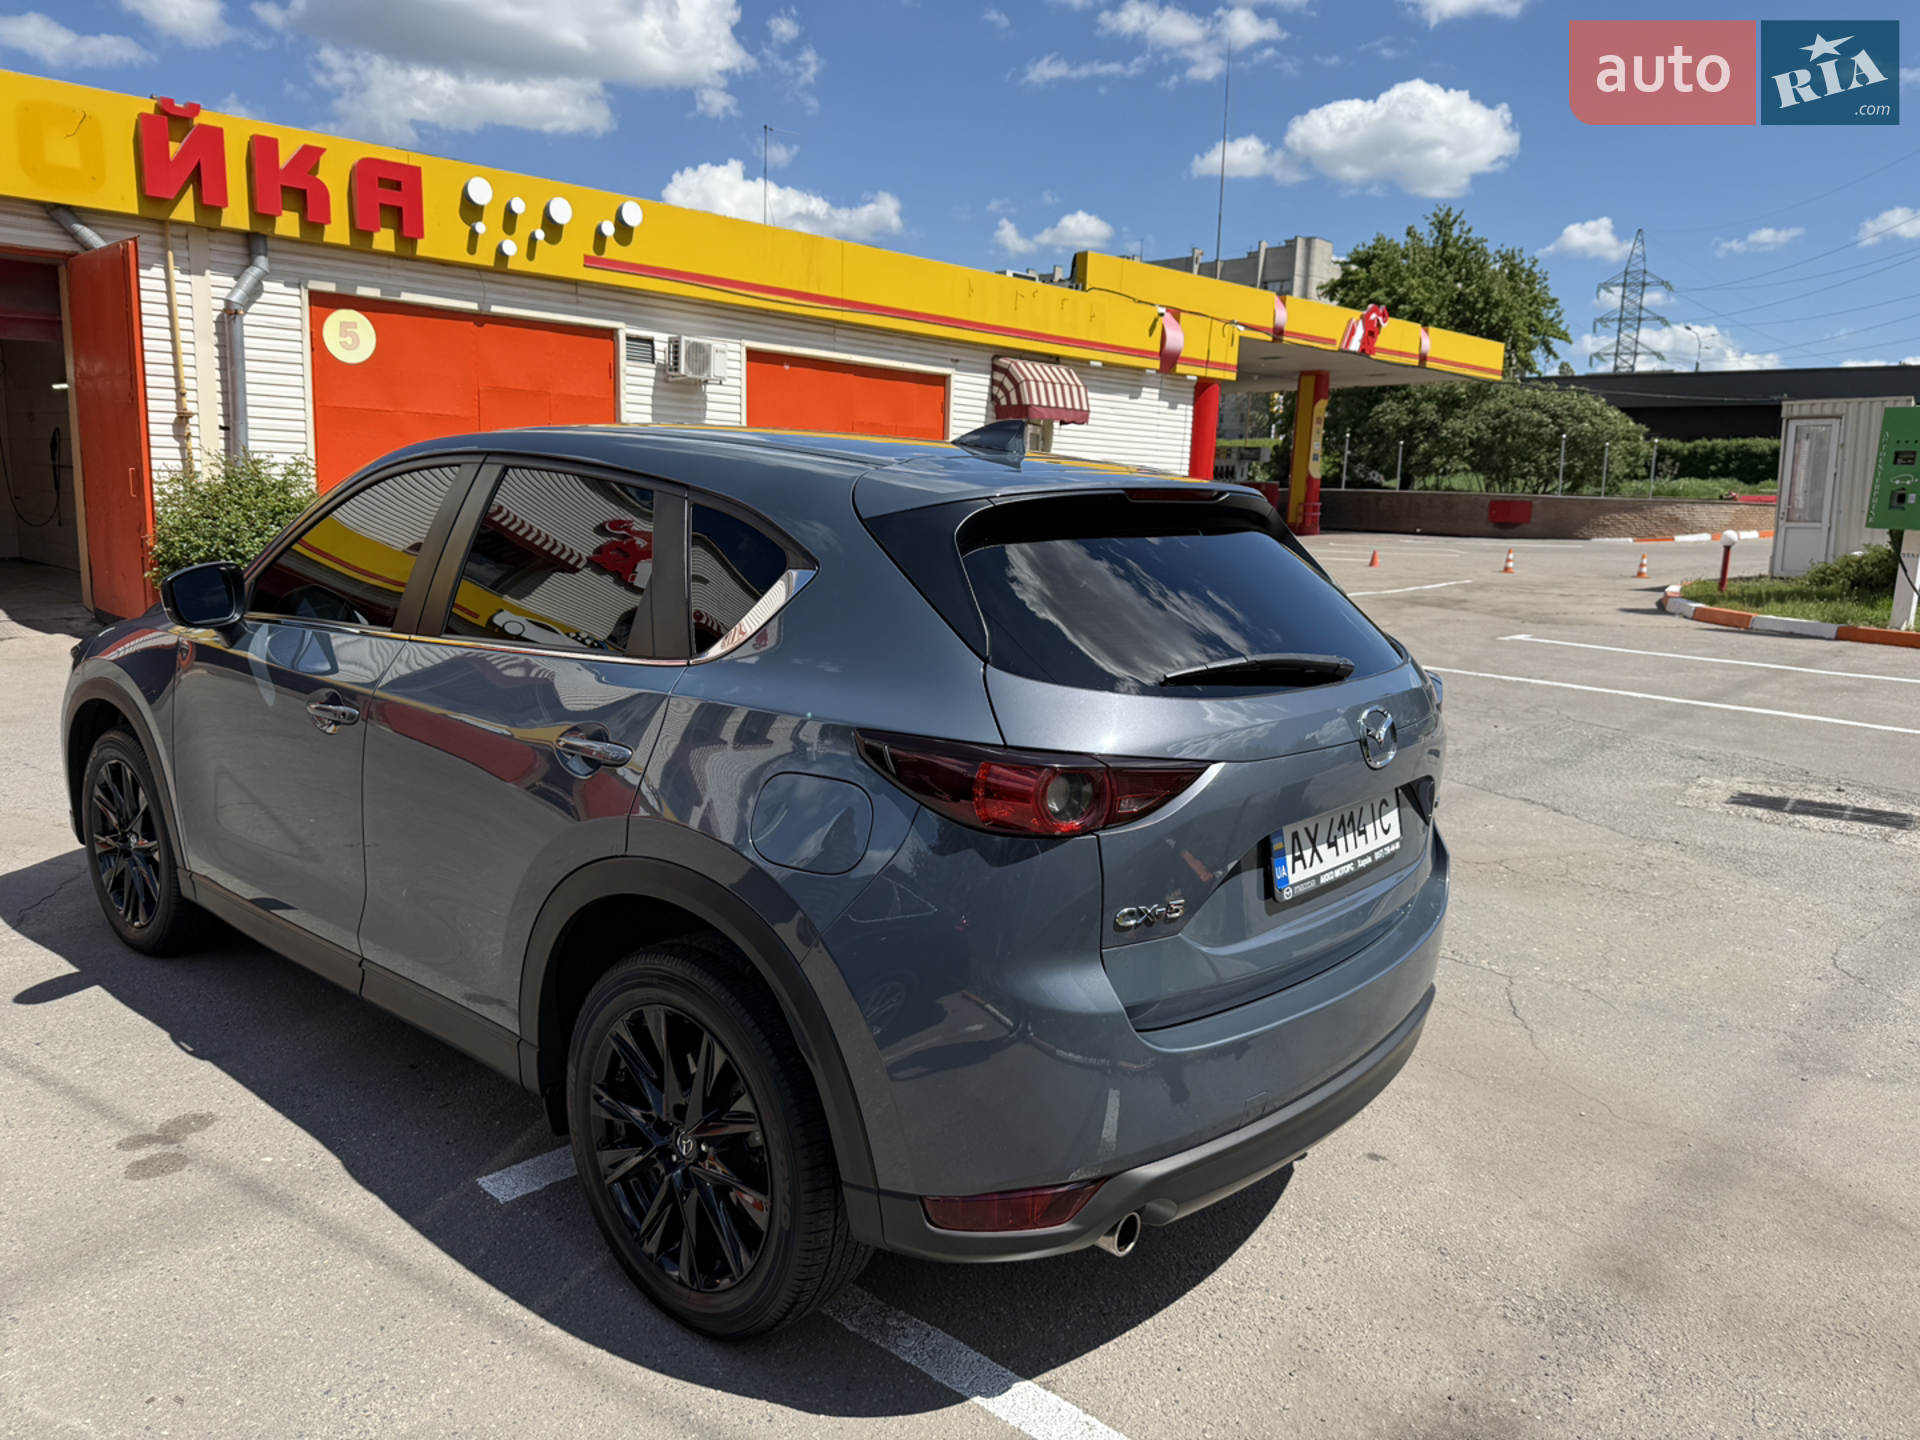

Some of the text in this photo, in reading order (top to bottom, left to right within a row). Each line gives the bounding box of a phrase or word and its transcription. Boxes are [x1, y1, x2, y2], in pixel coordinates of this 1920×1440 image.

[339, 321, 361, 351] 5
[1291, 798, 1391, 874] AX 4114 IC
[1275, 865, 1288, 879] UA
[1115, 899, 1185, 927] CX-5
